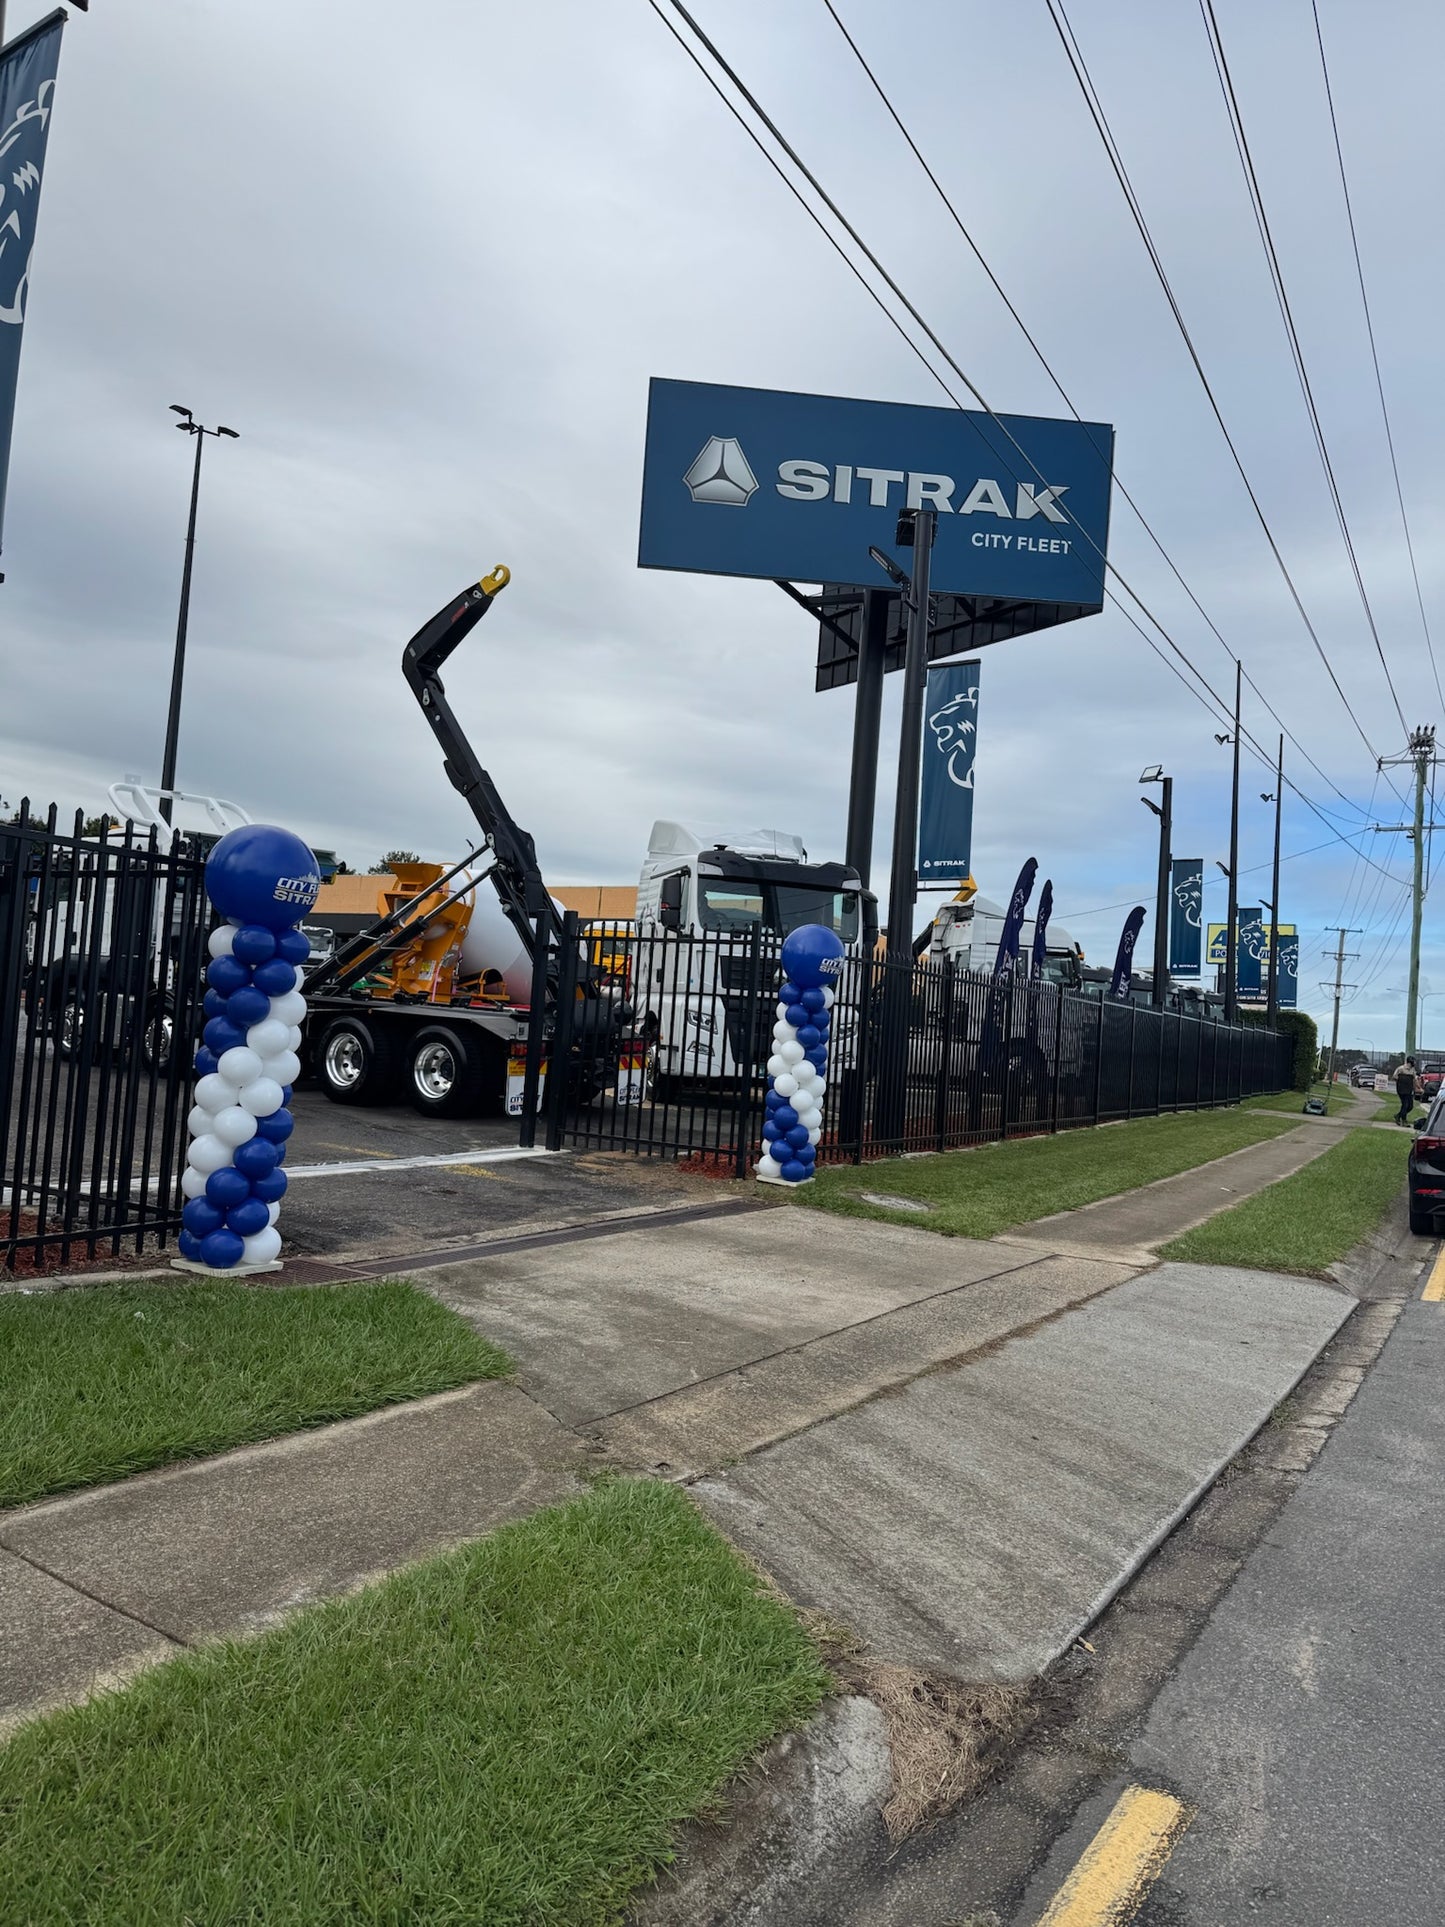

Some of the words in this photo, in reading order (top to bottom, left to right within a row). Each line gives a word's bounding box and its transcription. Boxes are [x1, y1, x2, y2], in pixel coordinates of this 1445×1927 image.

[774, 459, 1071, 525] SITRAK
[971, 532, 1013, 550] CITY
[1017, 536, 1072, 555] FLEET
[933, 859, 966, 867] SITRAK
[277, 877, 307, 891] CITY
[273, 890, 315, 905] SITRA
